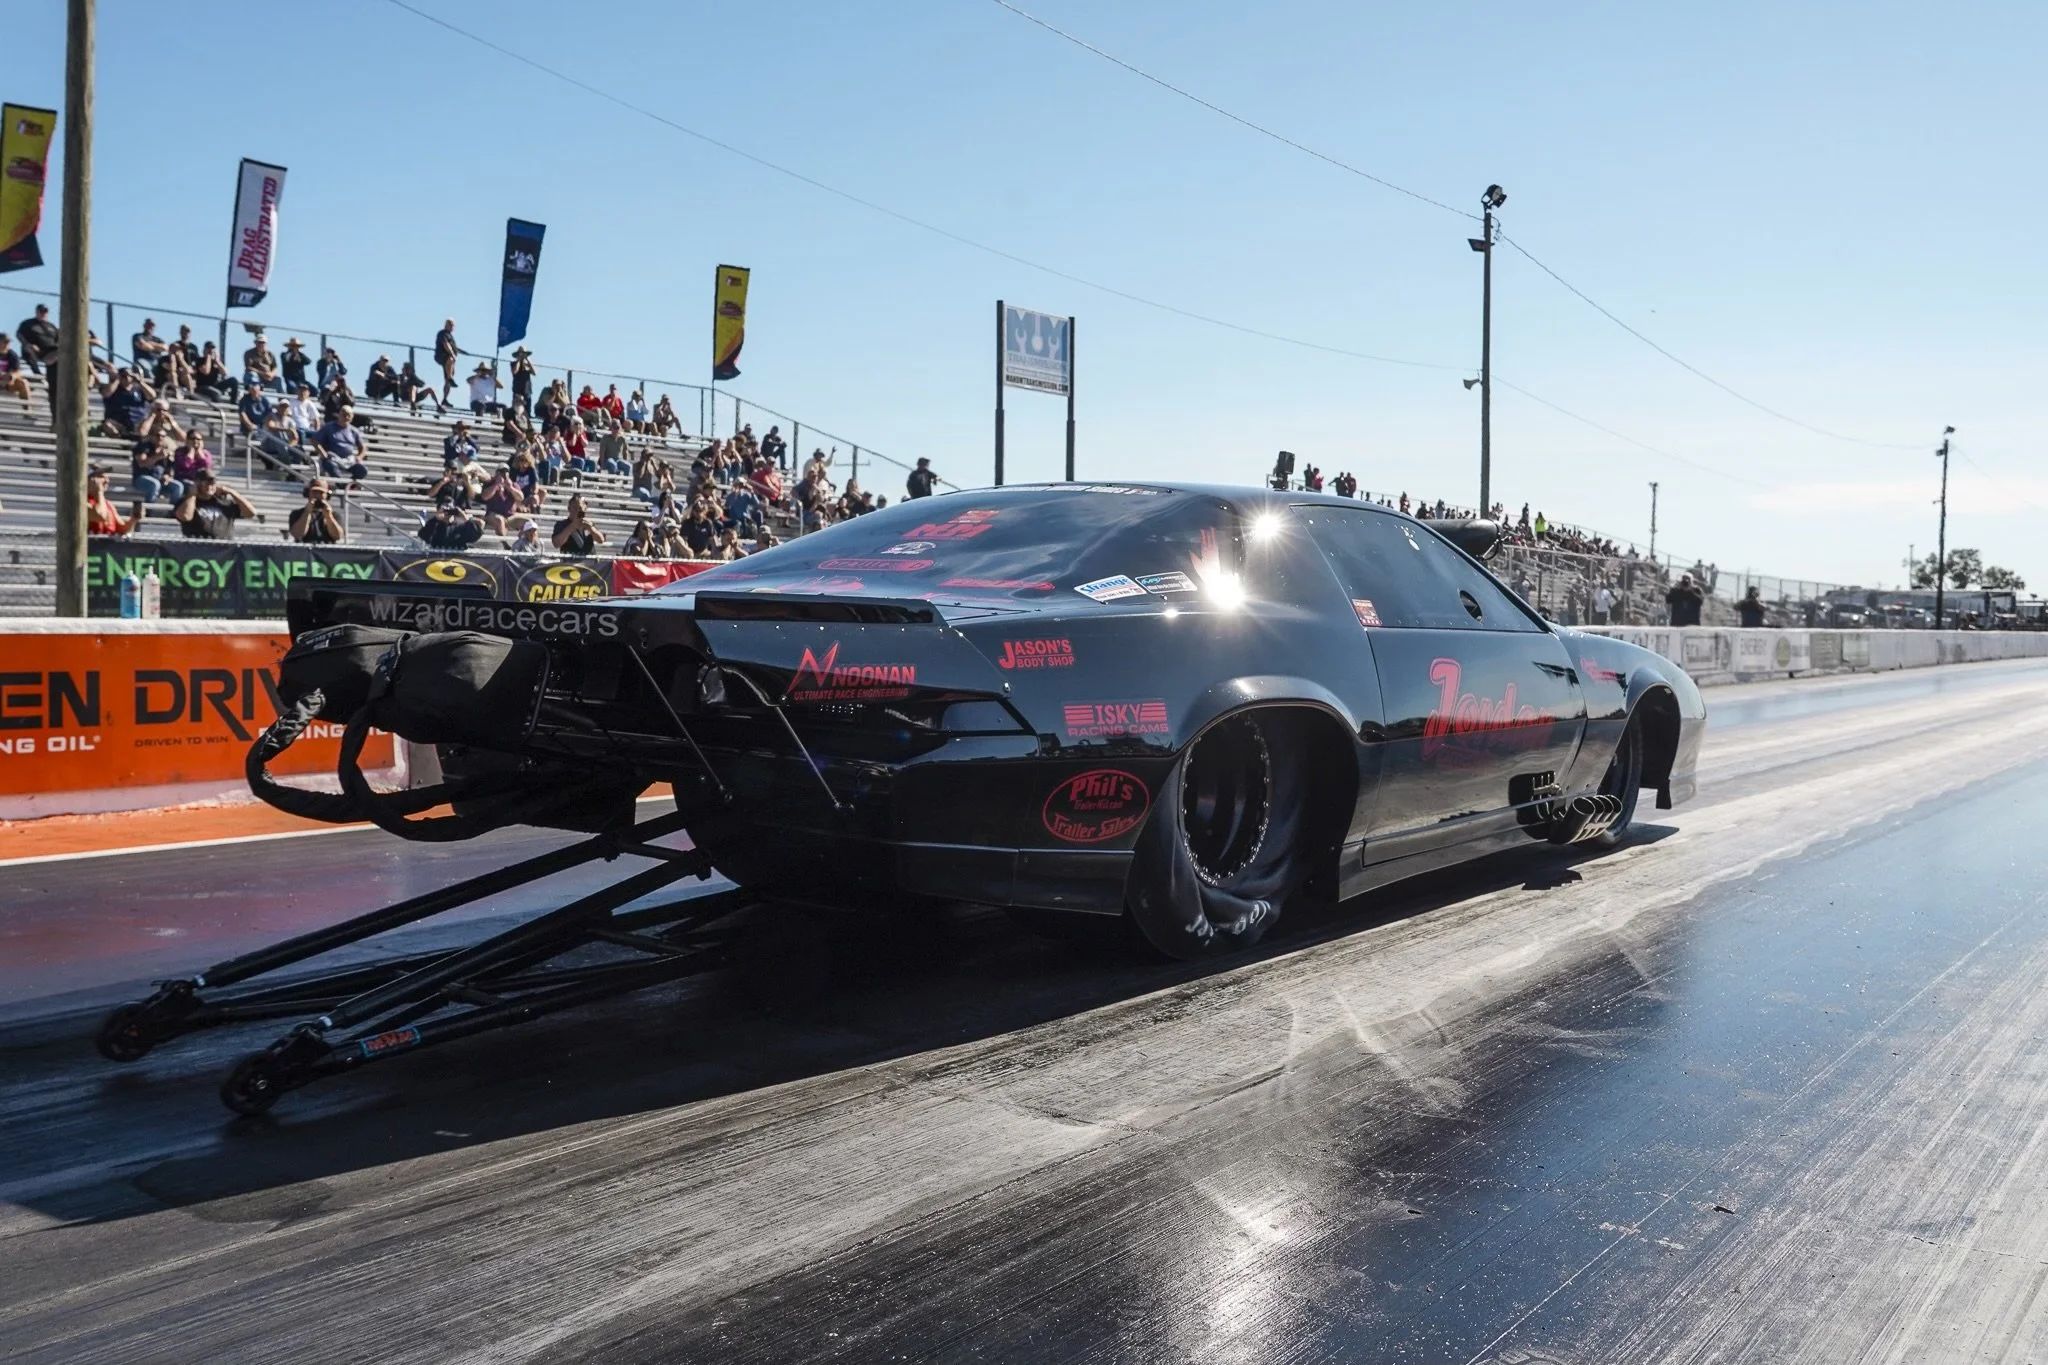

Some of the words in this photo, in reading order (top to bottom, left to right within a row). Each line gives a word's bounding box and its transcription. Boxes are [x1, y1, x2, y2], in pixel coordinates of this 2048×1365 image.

[248, 177, 278, 284] ILLUSTRATED
[237, 228, 260, 271] DRAG
[87, 552, 235, 588] ENERGY
[244, 557, 376, 590] ENERGY
[528, 584, 601, 602] CALLIES
[368, 599, 620, 637] wizardracecars
[998, 638, 1073, 669] JASON'S
[1016, 656, 1045, 668] BODY
[1048, 655, 1075, 666] SHOP
[832, 664, 916, 687] NOONAN
[134, 667, 294, 742] DRIV
[794, 689, 833, 700] ULTIMATE
[835, 688, 857, 699] RACE
[859, 687, 910, 698] ENGINEERING
[1095, 703, 1142, 725] ISKY
[135, 737, 182, 748] DRIVEN
[187, 736, 201, 746] TO
[206, 735, 229, 746] WIN
[1068, 725, 1125, 737] RACING
[1128, 722, 1169, 733] CAMS
[1069, 774, 1134, 801] Phil's
[1052, 812, 1096, 838] Trailer
[1098, 812, 1136, 836] Sales
